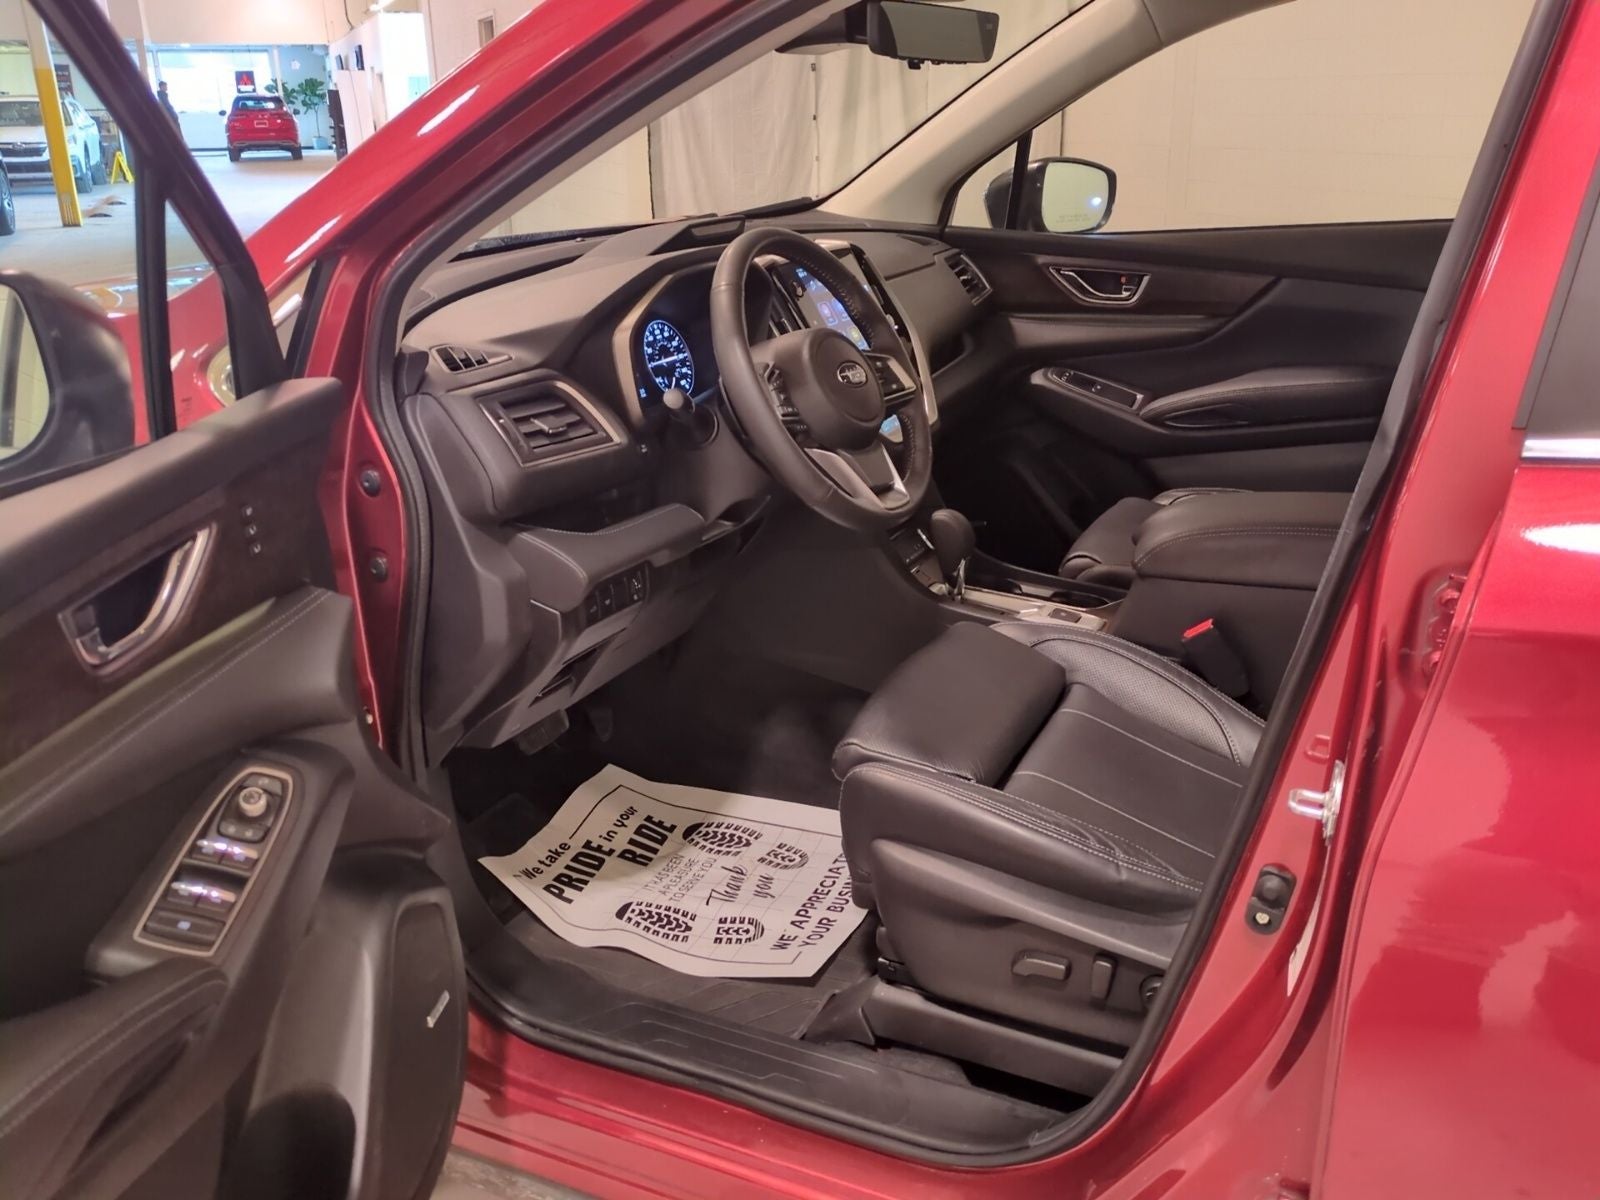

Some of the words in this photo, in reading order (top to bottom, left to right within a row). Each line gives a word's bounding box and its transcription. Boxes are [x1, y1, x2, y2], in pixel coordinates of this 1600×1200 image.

[542, 839, 616, 904] PRIDE
[599, 828, 618, 842] in
[613, 806, 639, 829] your
[616, 815, 678, 867] RIDE
[519, 866, 544, 880] We
[538, 842, 571, 867] take
[652, 871, 669, 885] HAS
[663, 853, 685, 873] BEEN
[662, 858, 699, 890] PLEASURE
[669, 892, 685, 902] TO
[679, 872, 705, 892] SERVE
[698, 858, 717, 873] YOU
[705, 865, 748, 906] Thank
[753, 873, 776, 899] you
[770, 934, 799, 950] WE
[798, 917, 838, 947] YOUR
